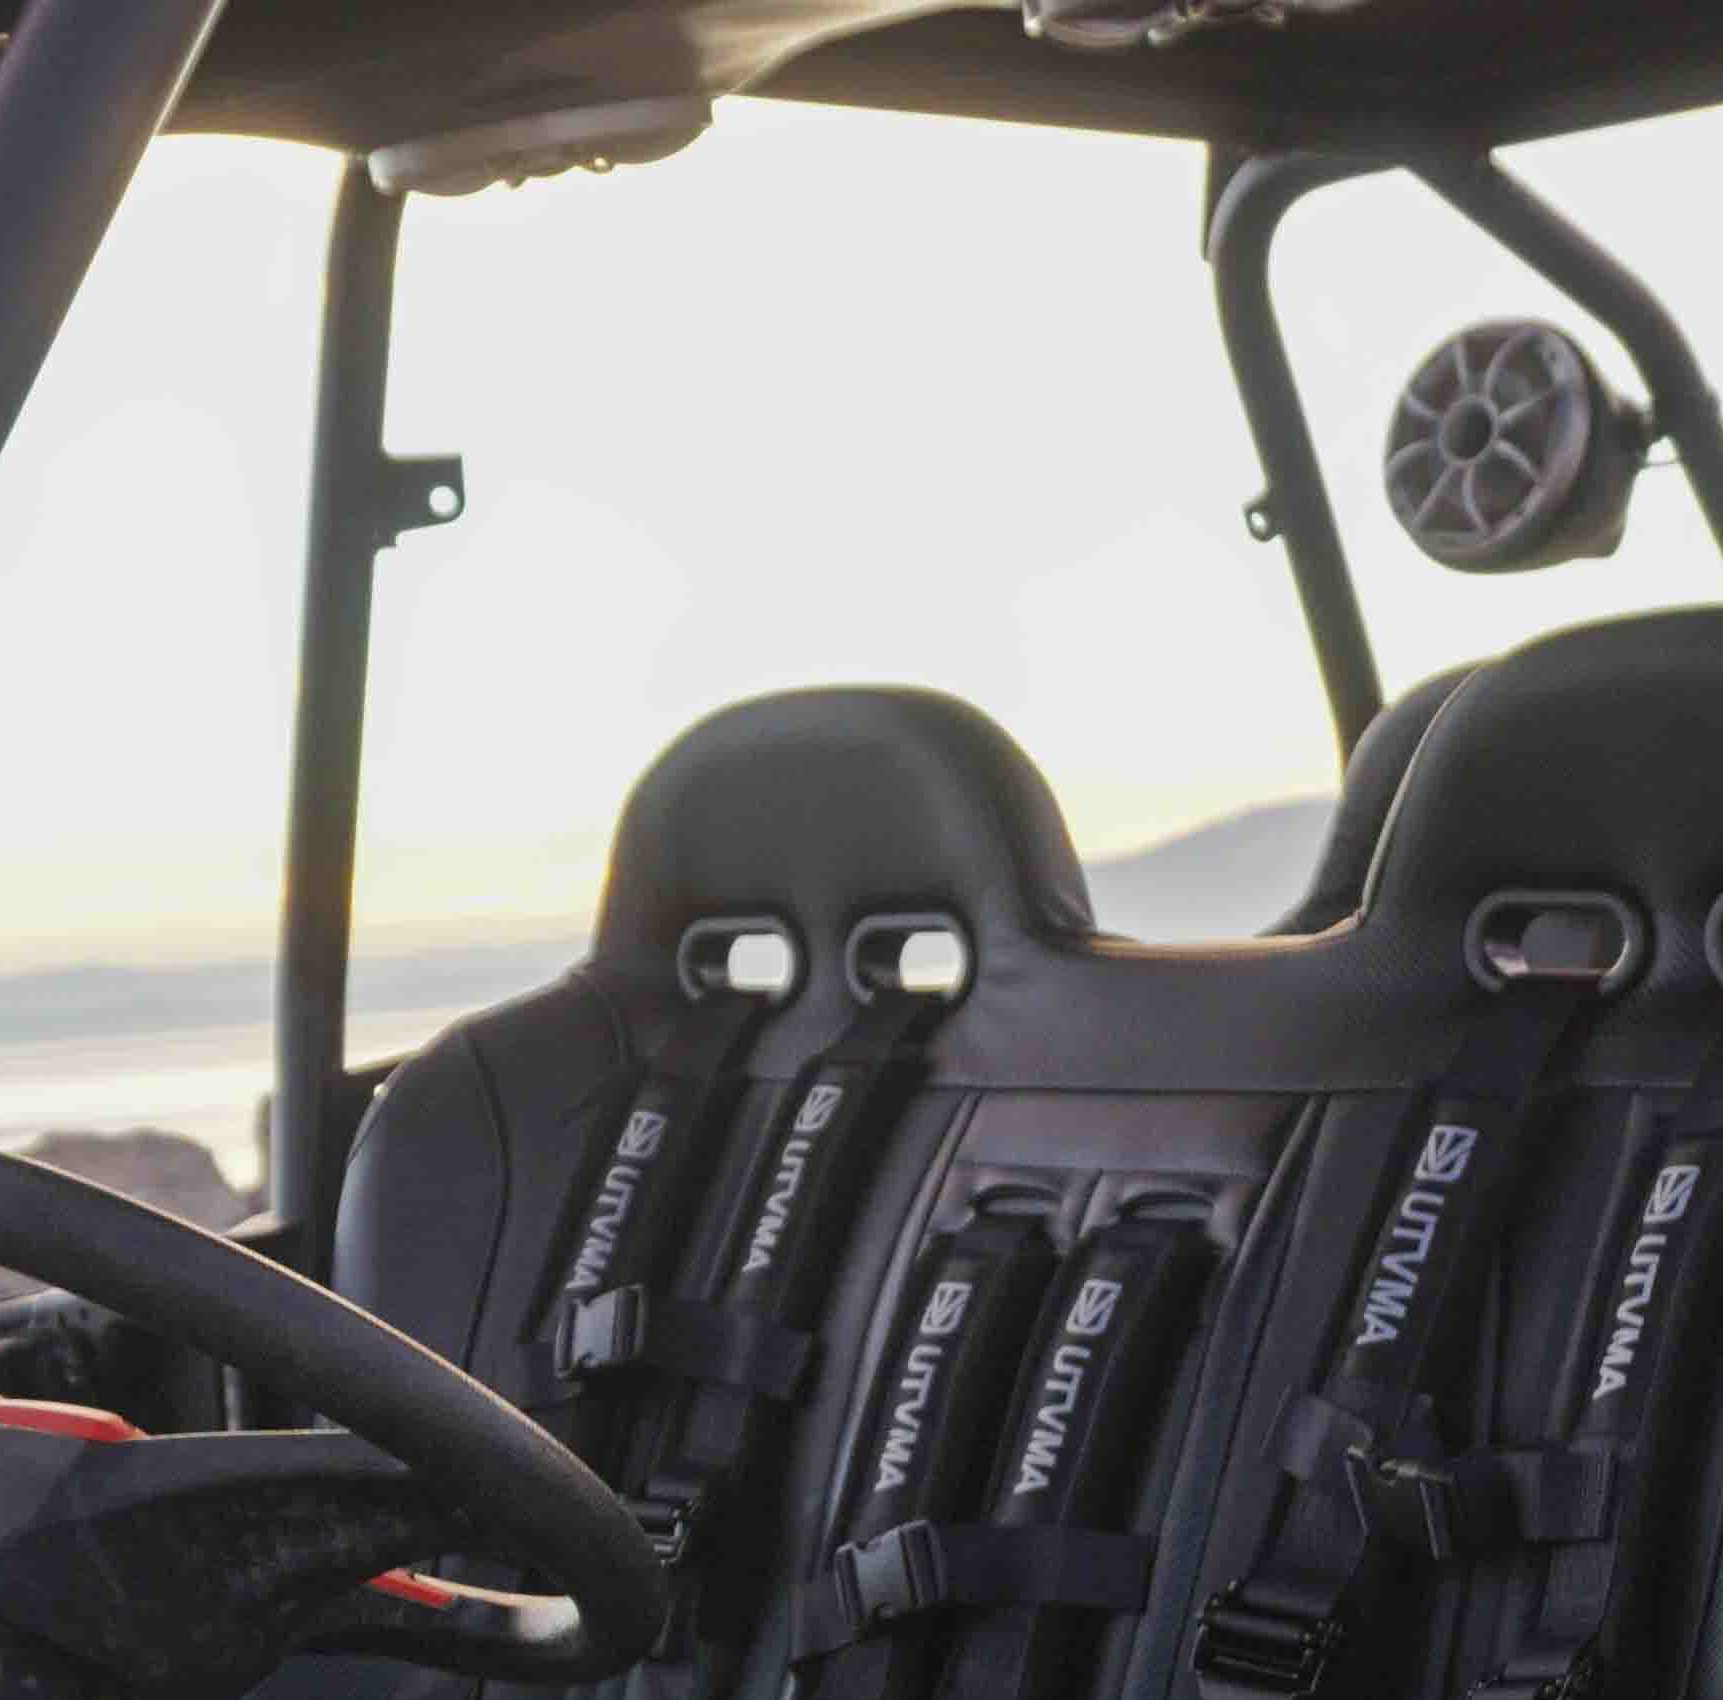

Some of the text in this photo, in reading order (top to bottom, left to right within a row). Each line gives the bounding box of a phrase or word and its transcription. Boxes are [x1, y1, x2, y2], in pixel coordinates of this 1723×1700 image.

[739, 1138, 812, 1274] UTVMA
[1356, 1193, 1445, 1346] UTVMA
[1592, 1233, 1667, 1402] UTVMA
[874, 1345, 943, 1494] UTVMA
[1012, 1346, 1092, 1496] UTVMA
